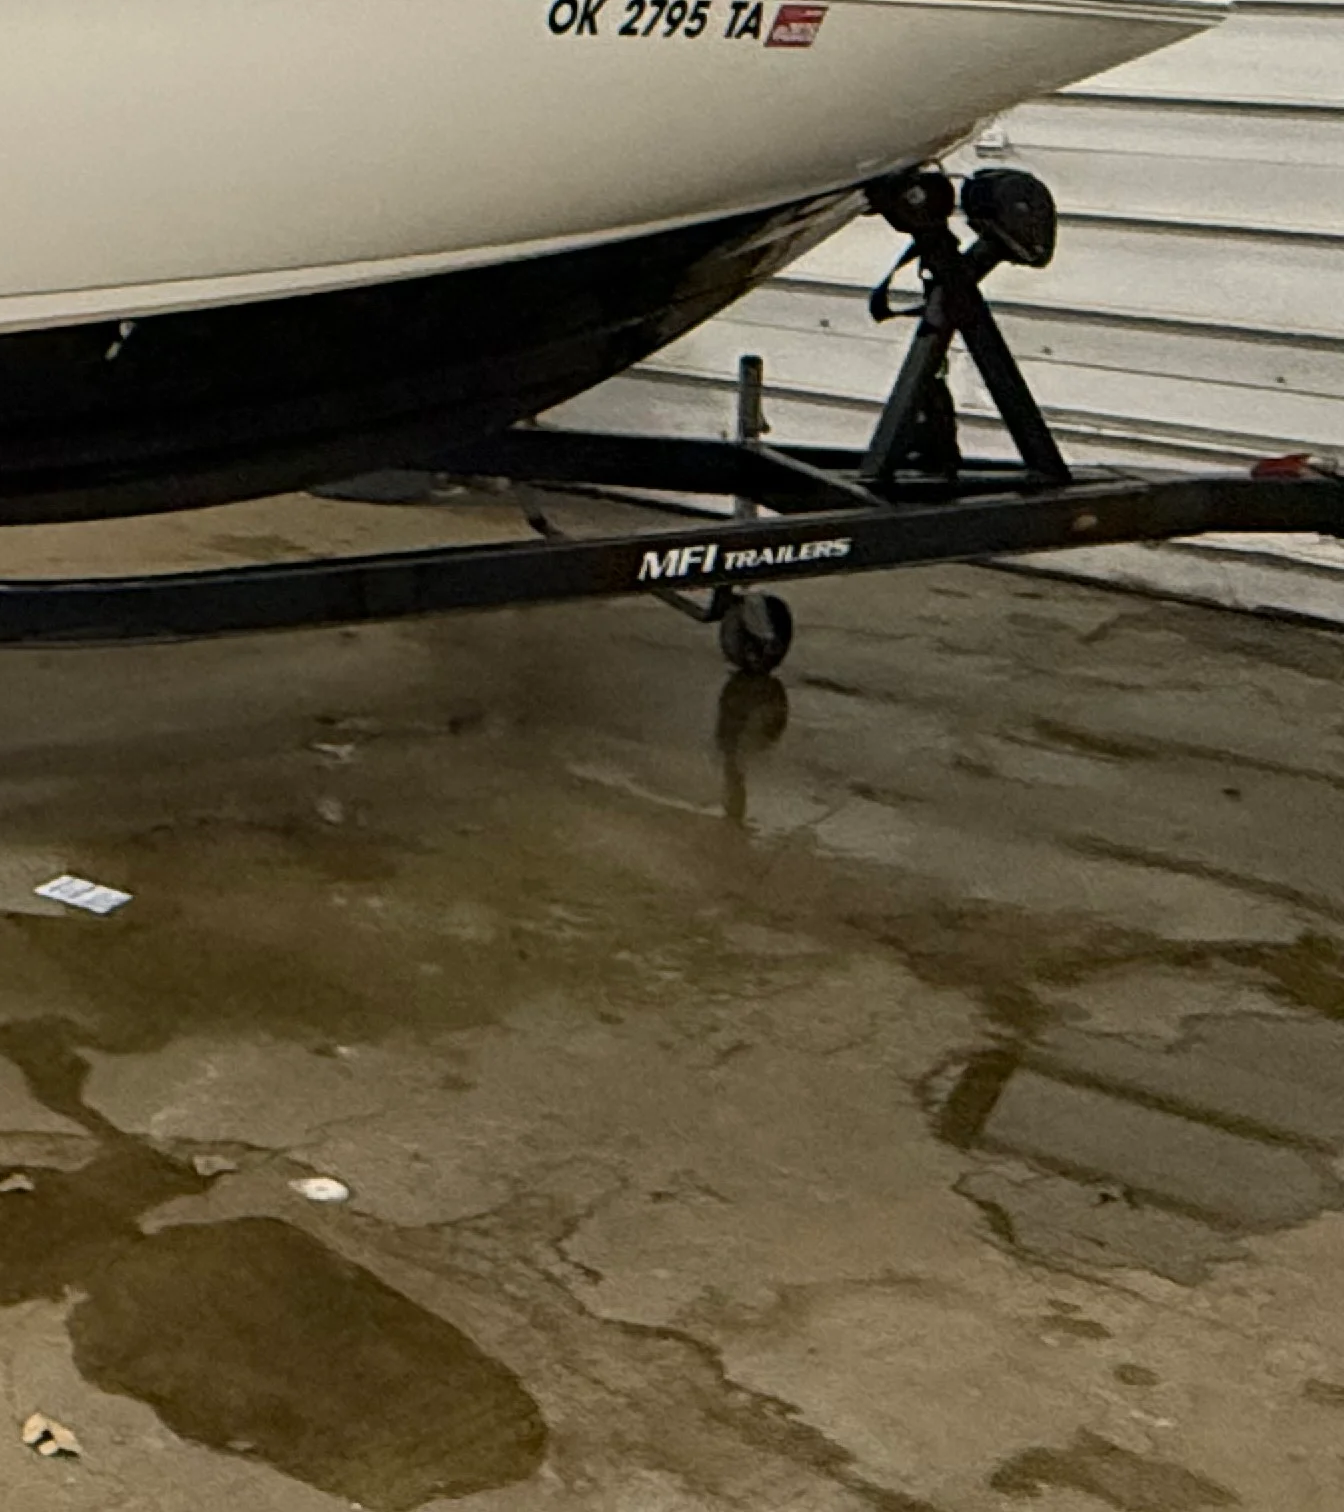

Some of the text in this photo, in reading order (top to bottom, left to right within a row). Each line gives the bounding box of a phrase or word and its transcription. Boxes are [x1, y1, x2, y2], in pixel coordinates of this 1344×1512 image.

[724, 1, 764, 40] TA
[638, 537, 852, 581] MFI TRAILERS
